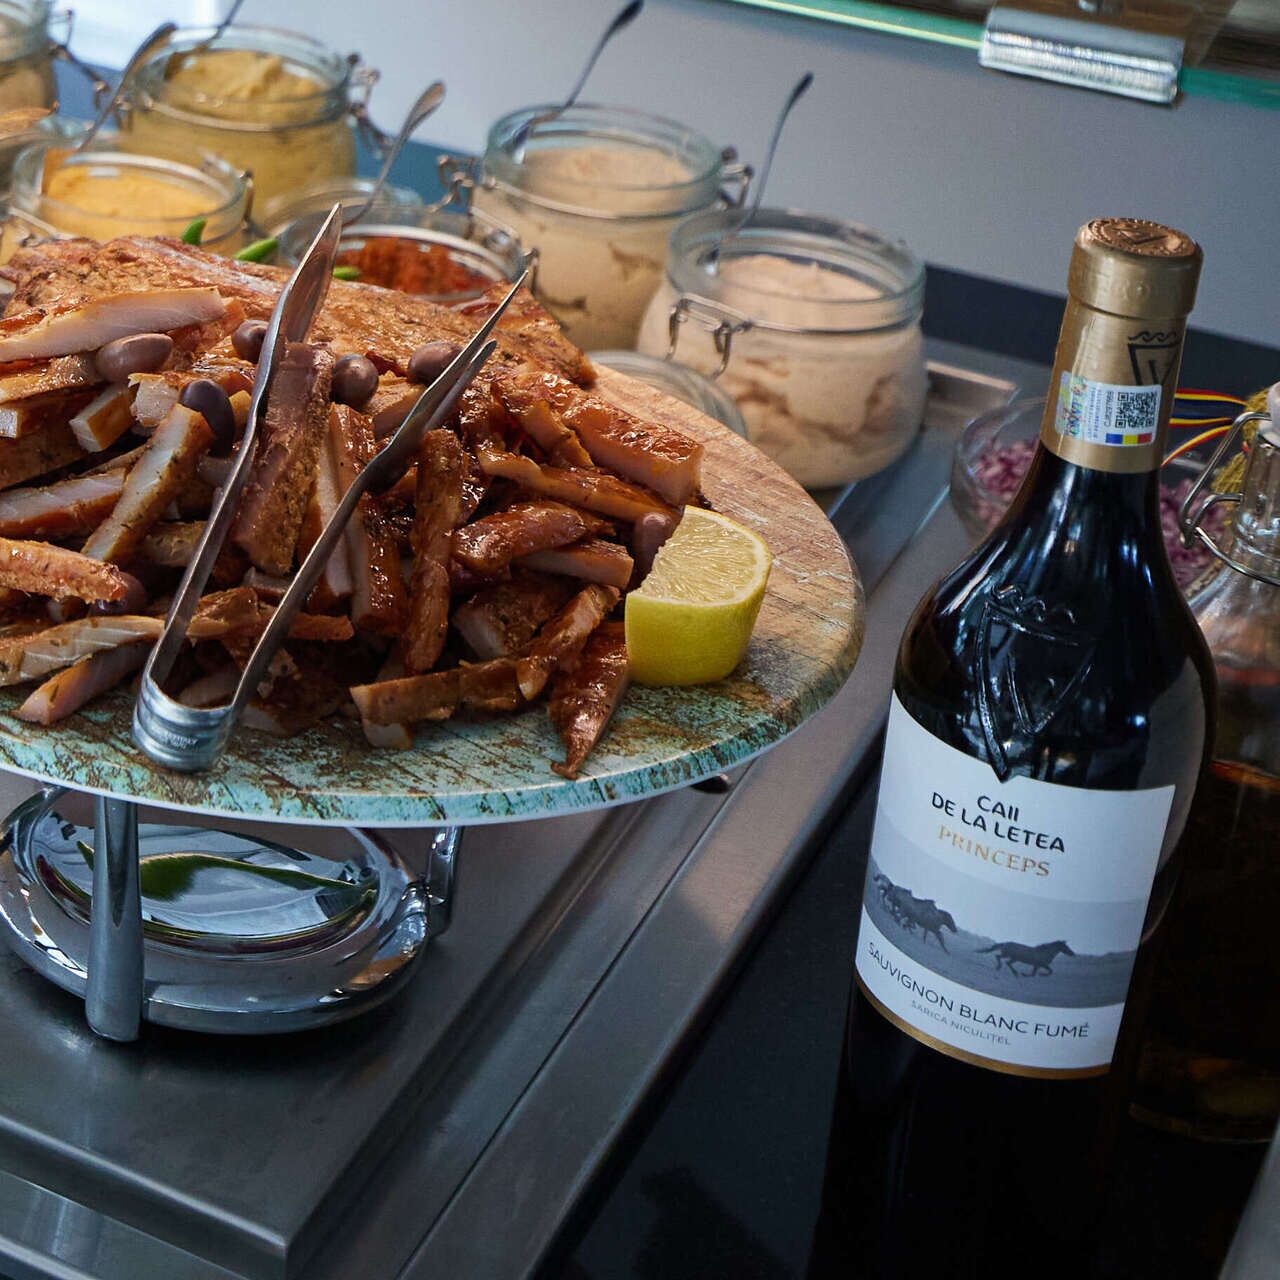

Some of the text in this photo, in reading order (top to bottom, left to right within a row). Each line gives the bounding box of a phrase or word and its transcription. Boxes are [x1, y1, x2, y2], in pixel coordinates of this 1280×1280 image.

[931, 792, 1065, 853] DE LA LETEA
[977, 795, 1020, 822] CAII
[938, 823, 1051, 878] PRINCEPS
[868, 941, 1090, 1038] SAUVIGNON BLANC FUMÉ
[911, 999, 948, 1024] SARICA
